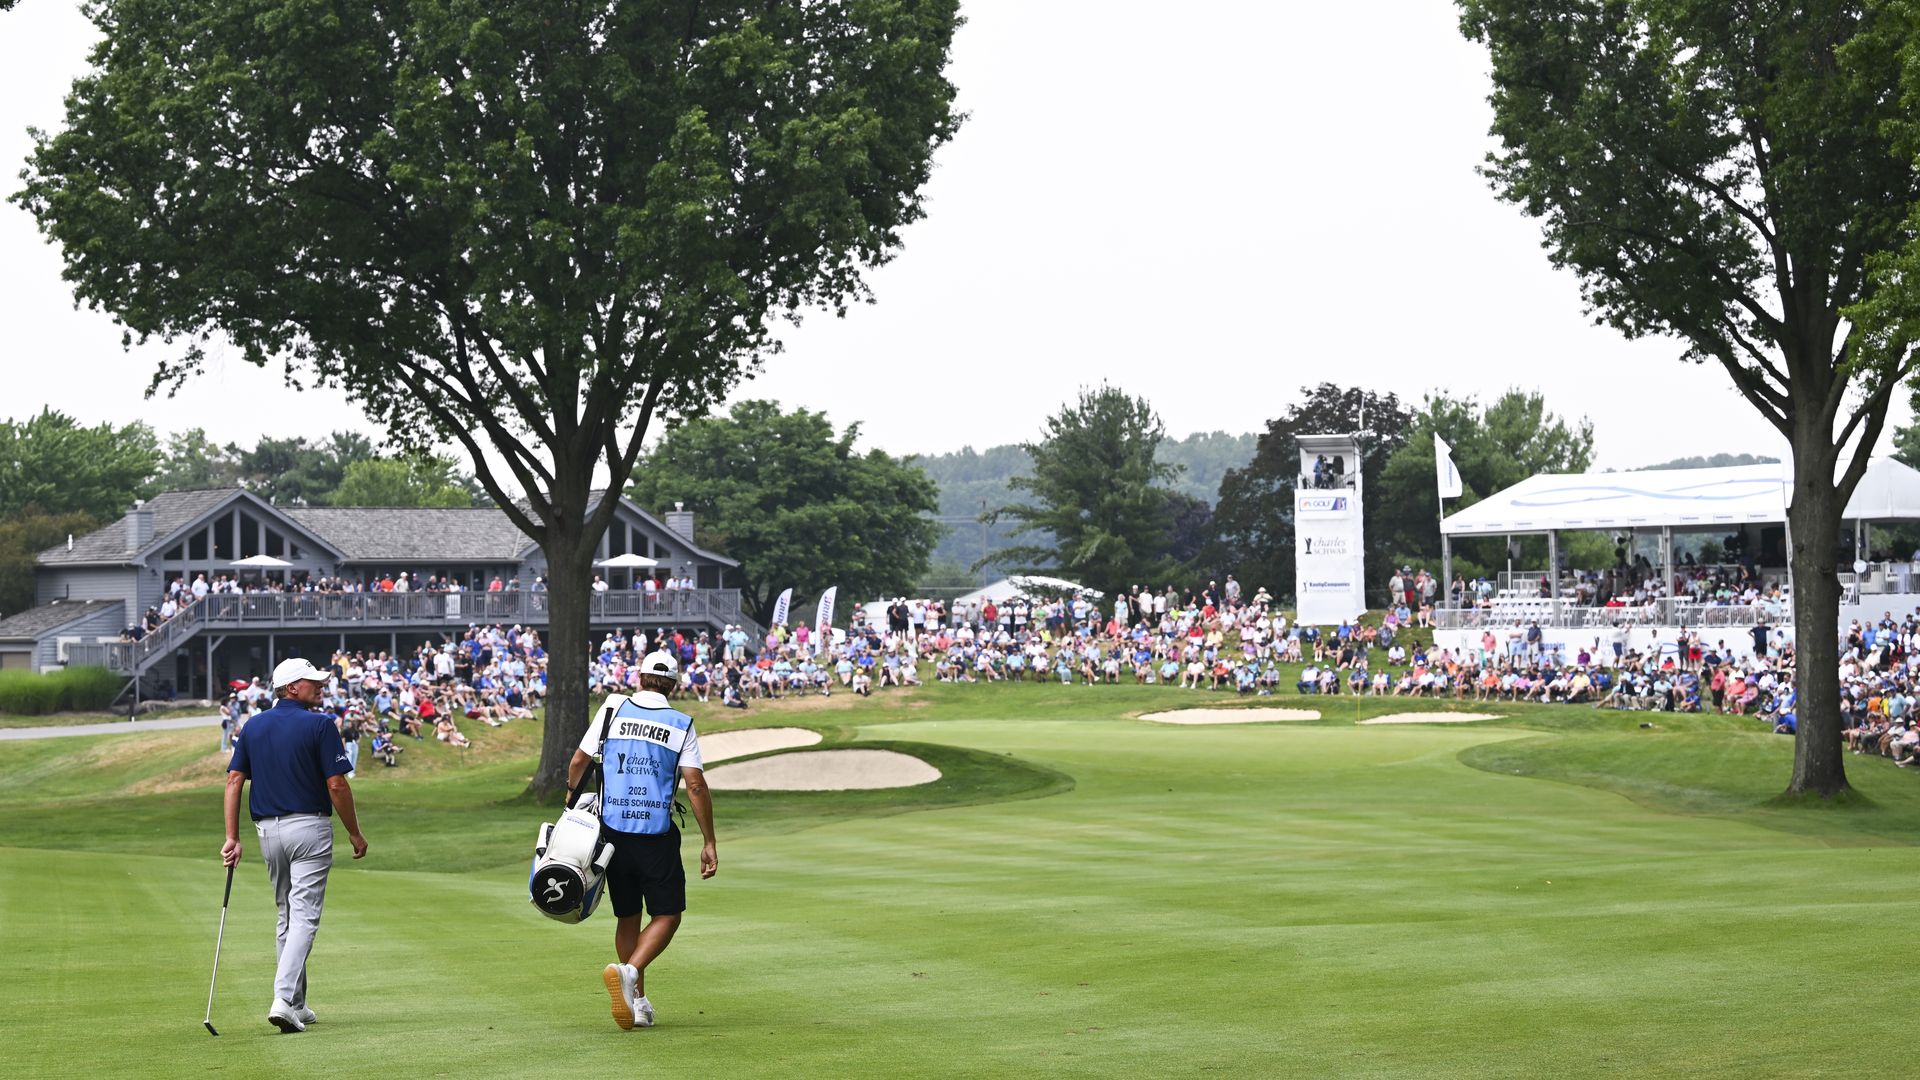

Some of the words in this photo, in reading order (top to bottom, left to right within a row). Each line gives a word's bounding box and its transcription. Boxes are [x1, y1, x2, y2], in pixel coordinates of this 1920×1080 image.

[1313, 536, 1346, 547] charles
[620, 722, 671, 744] STRICKER
[626, 752, 662, 769] charles
[628, 786, 647, 796] 2023
[631, 799, 661, 809] SCHWAB
[621, 810, 651, 820] LEADER
